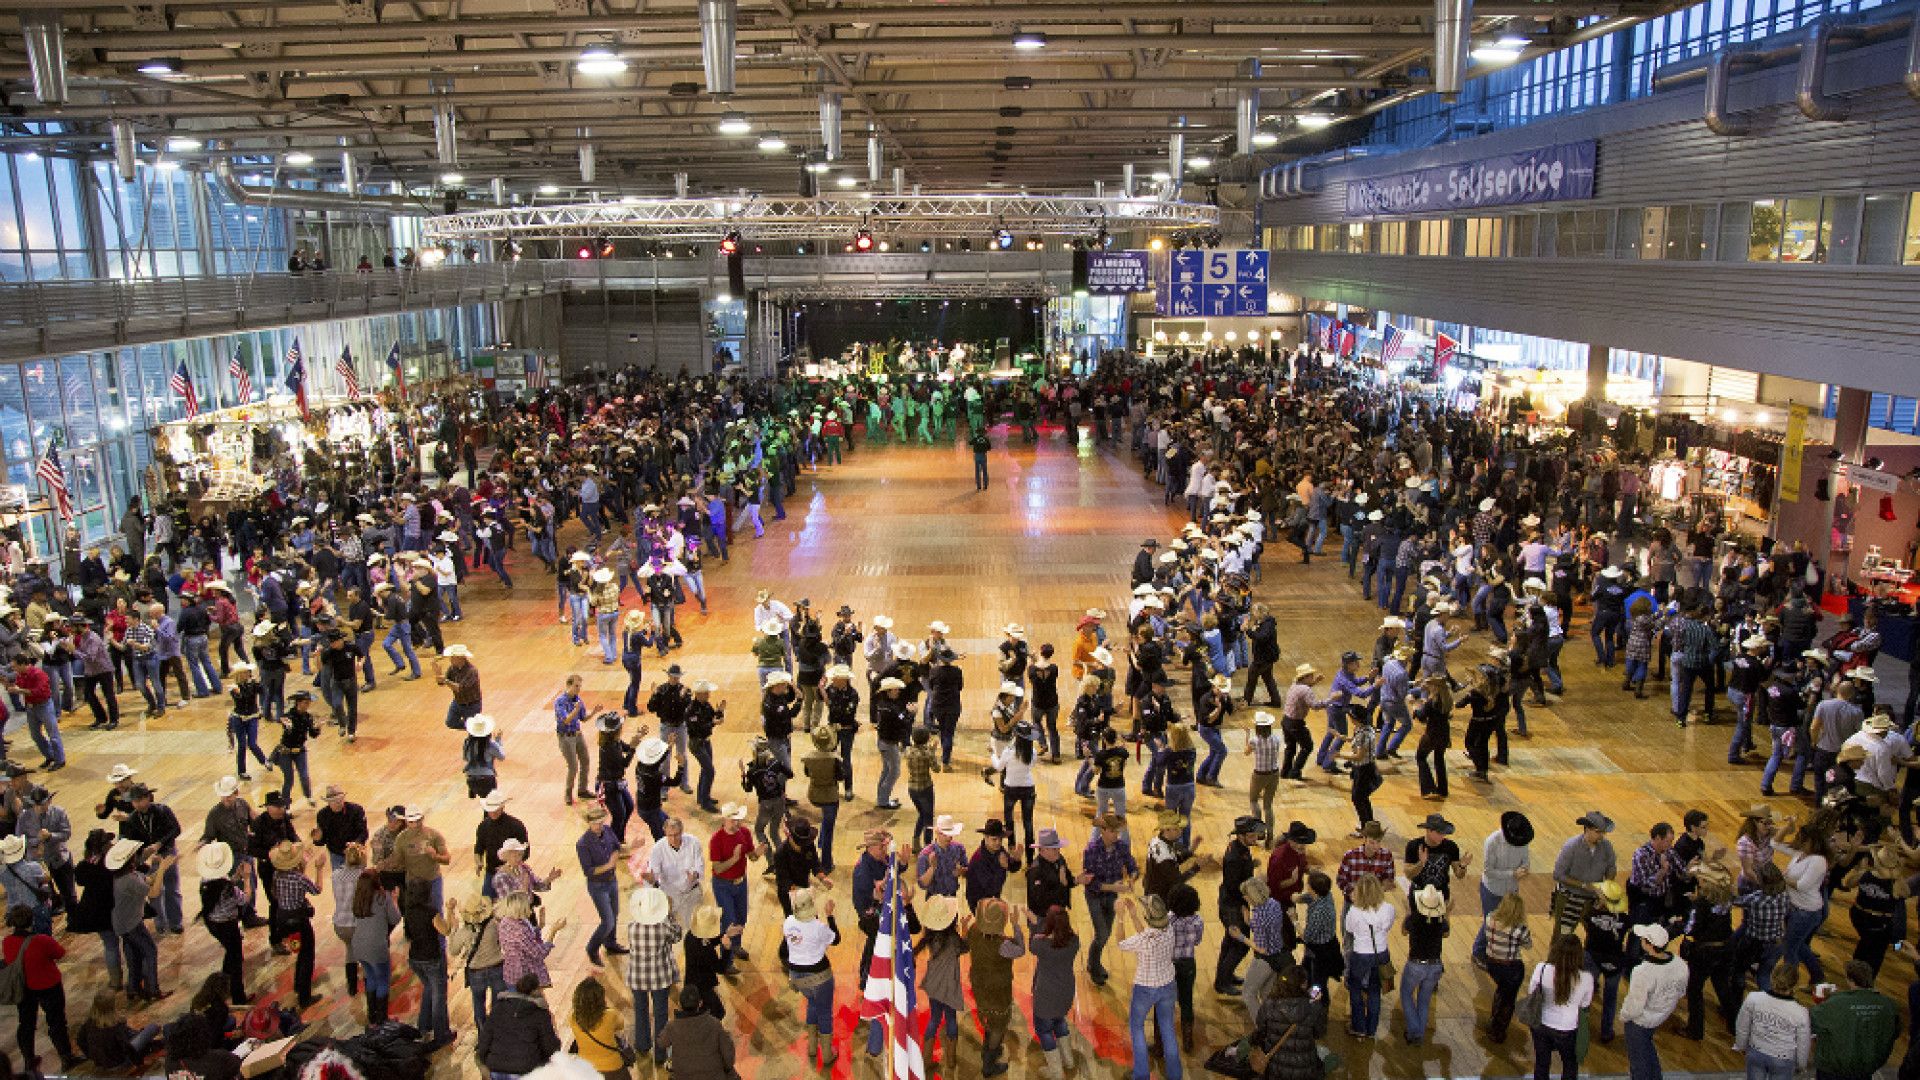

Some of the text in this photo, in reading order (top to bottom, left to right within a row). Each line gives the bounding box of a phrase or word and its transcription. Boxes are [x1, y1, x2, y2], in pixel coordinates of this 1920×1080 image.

[1447, 156, 1564, 204] Selfservice
[1093, 258, 1141, 268] LA MOSTRA
[1209, 252, 1229, 279] 5
[1090, 267, 1133, 276] PROSEGUE
[1254, 266, 1266, 283] 4
[1088, 275, 1138, 285] PADIGLIONE
